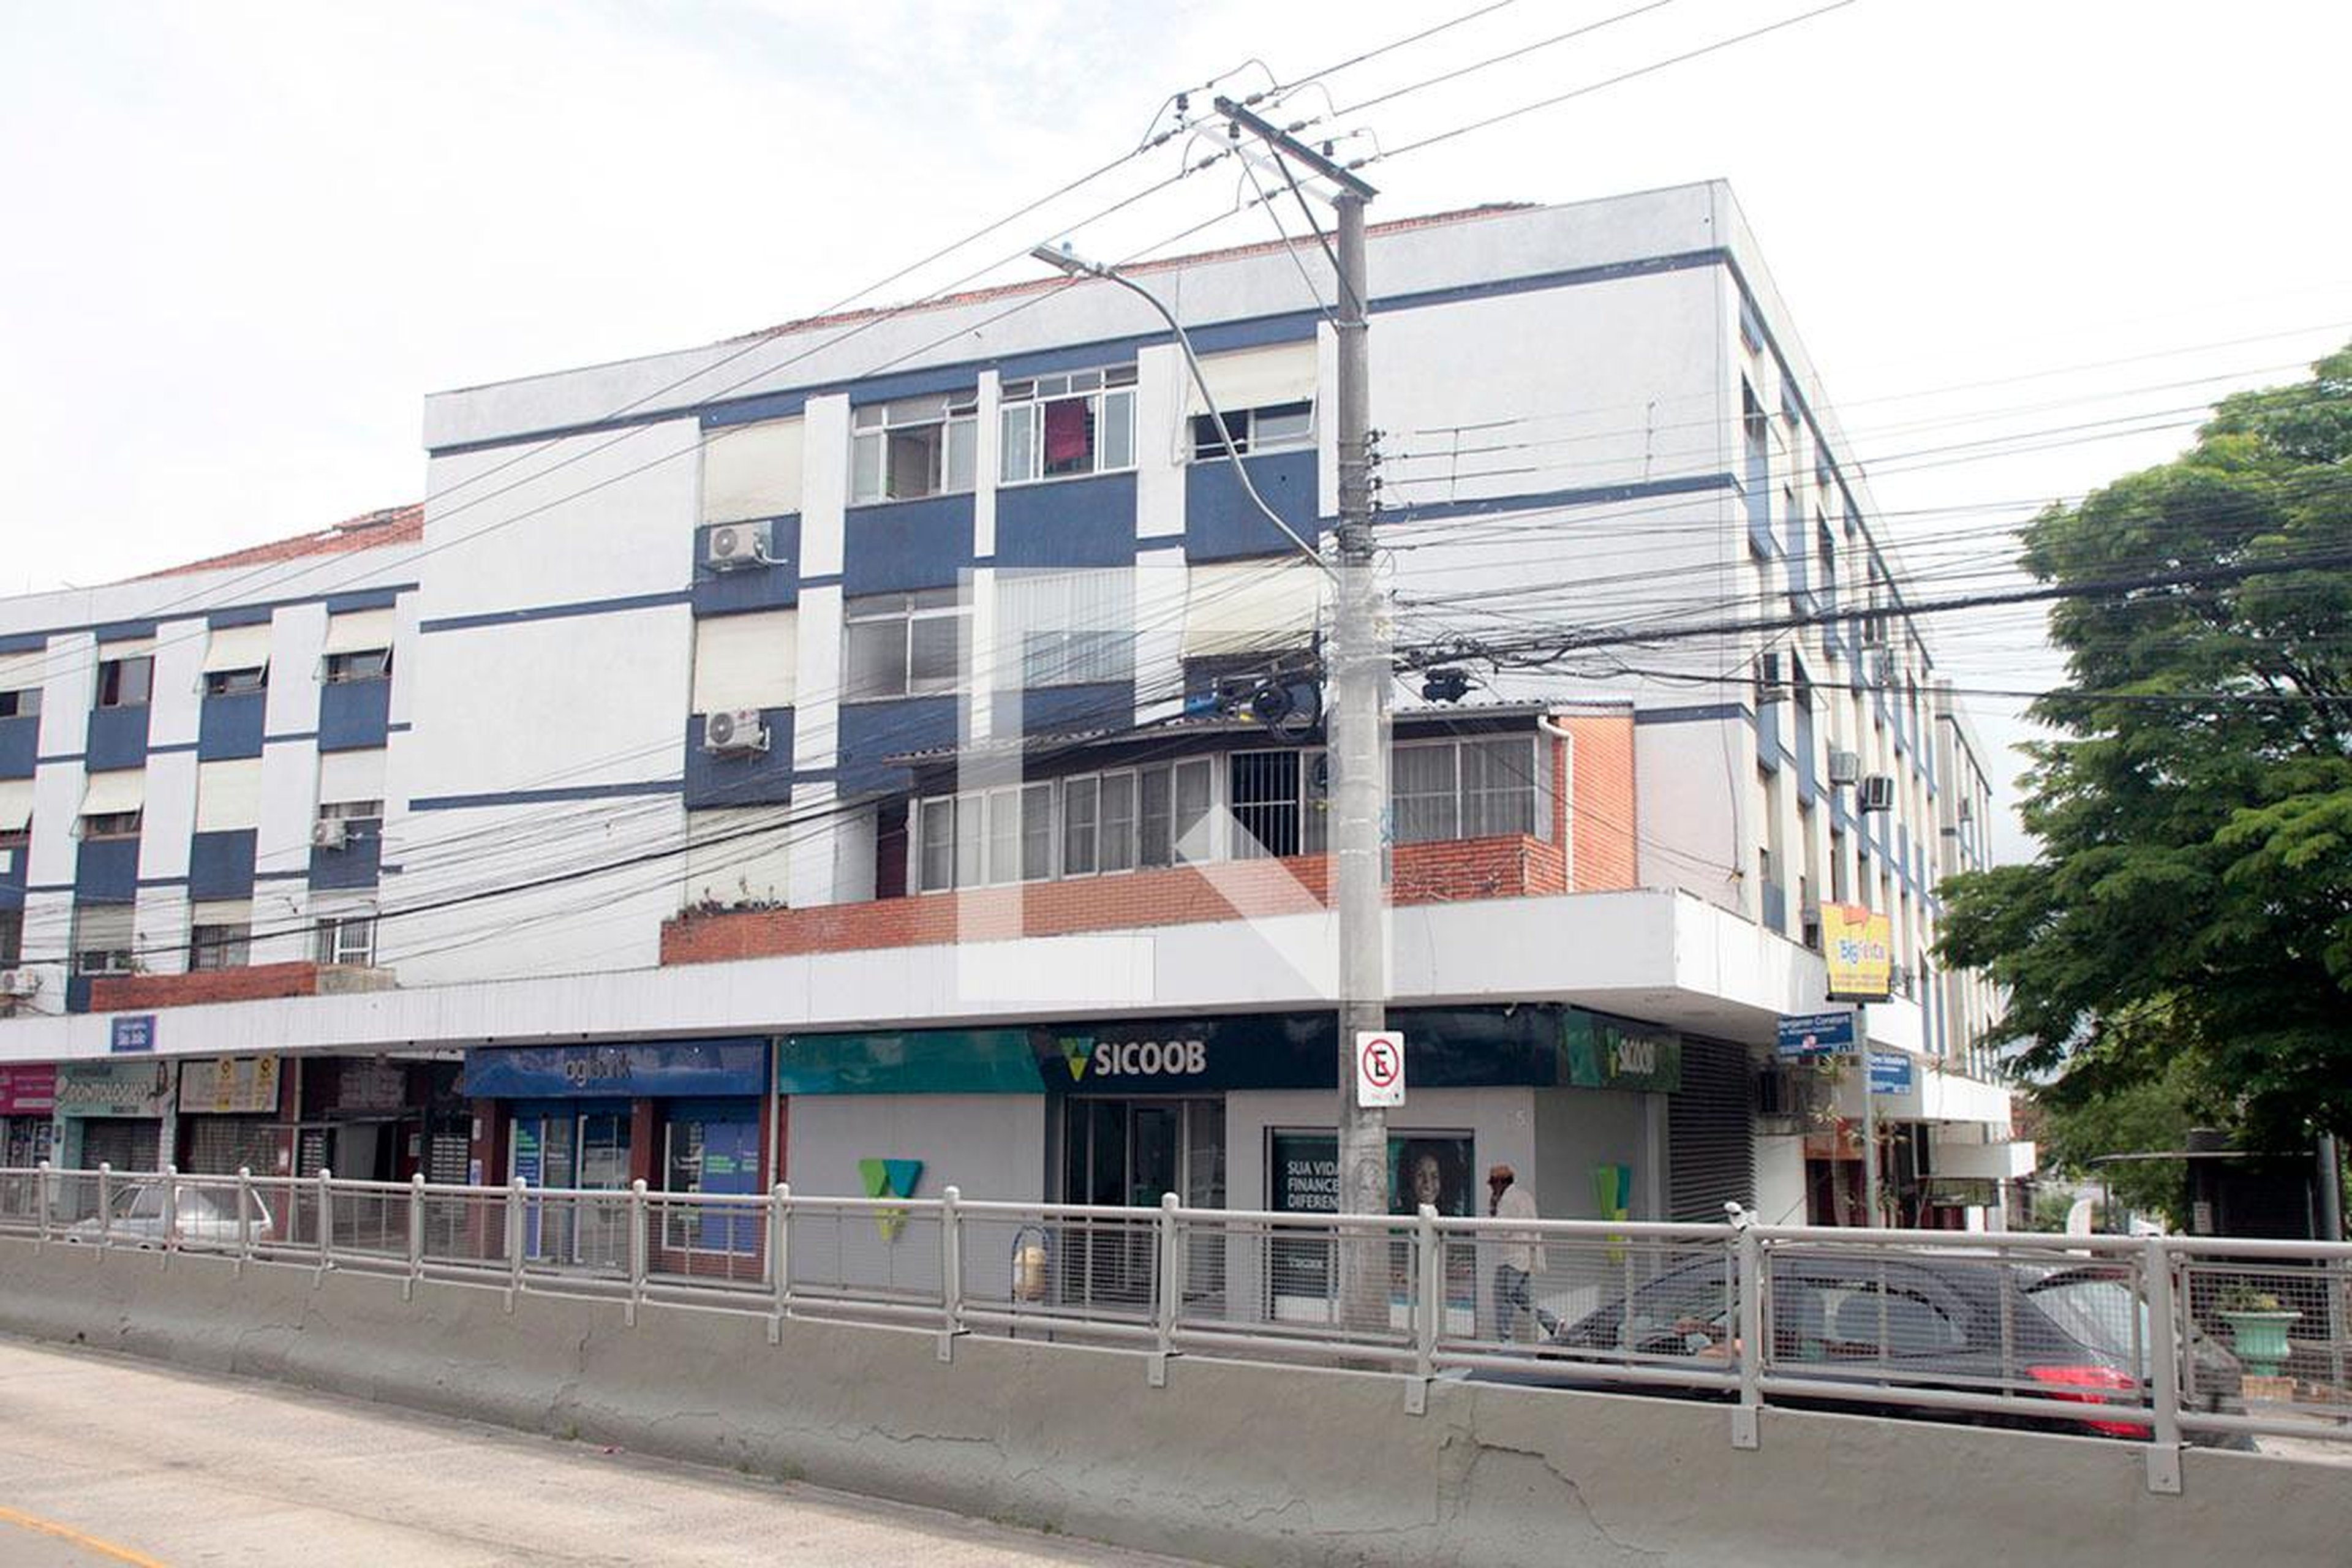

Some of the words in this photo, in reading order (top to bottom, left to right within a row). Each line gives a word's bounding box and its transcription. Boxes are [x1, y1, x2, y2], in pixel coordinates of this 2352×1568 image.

[1095, 1041, 1207, 1076] SICOOB
[1375, 1050, 1387, 1077] E
[1287, 1161, 1312, 1176] SUA
